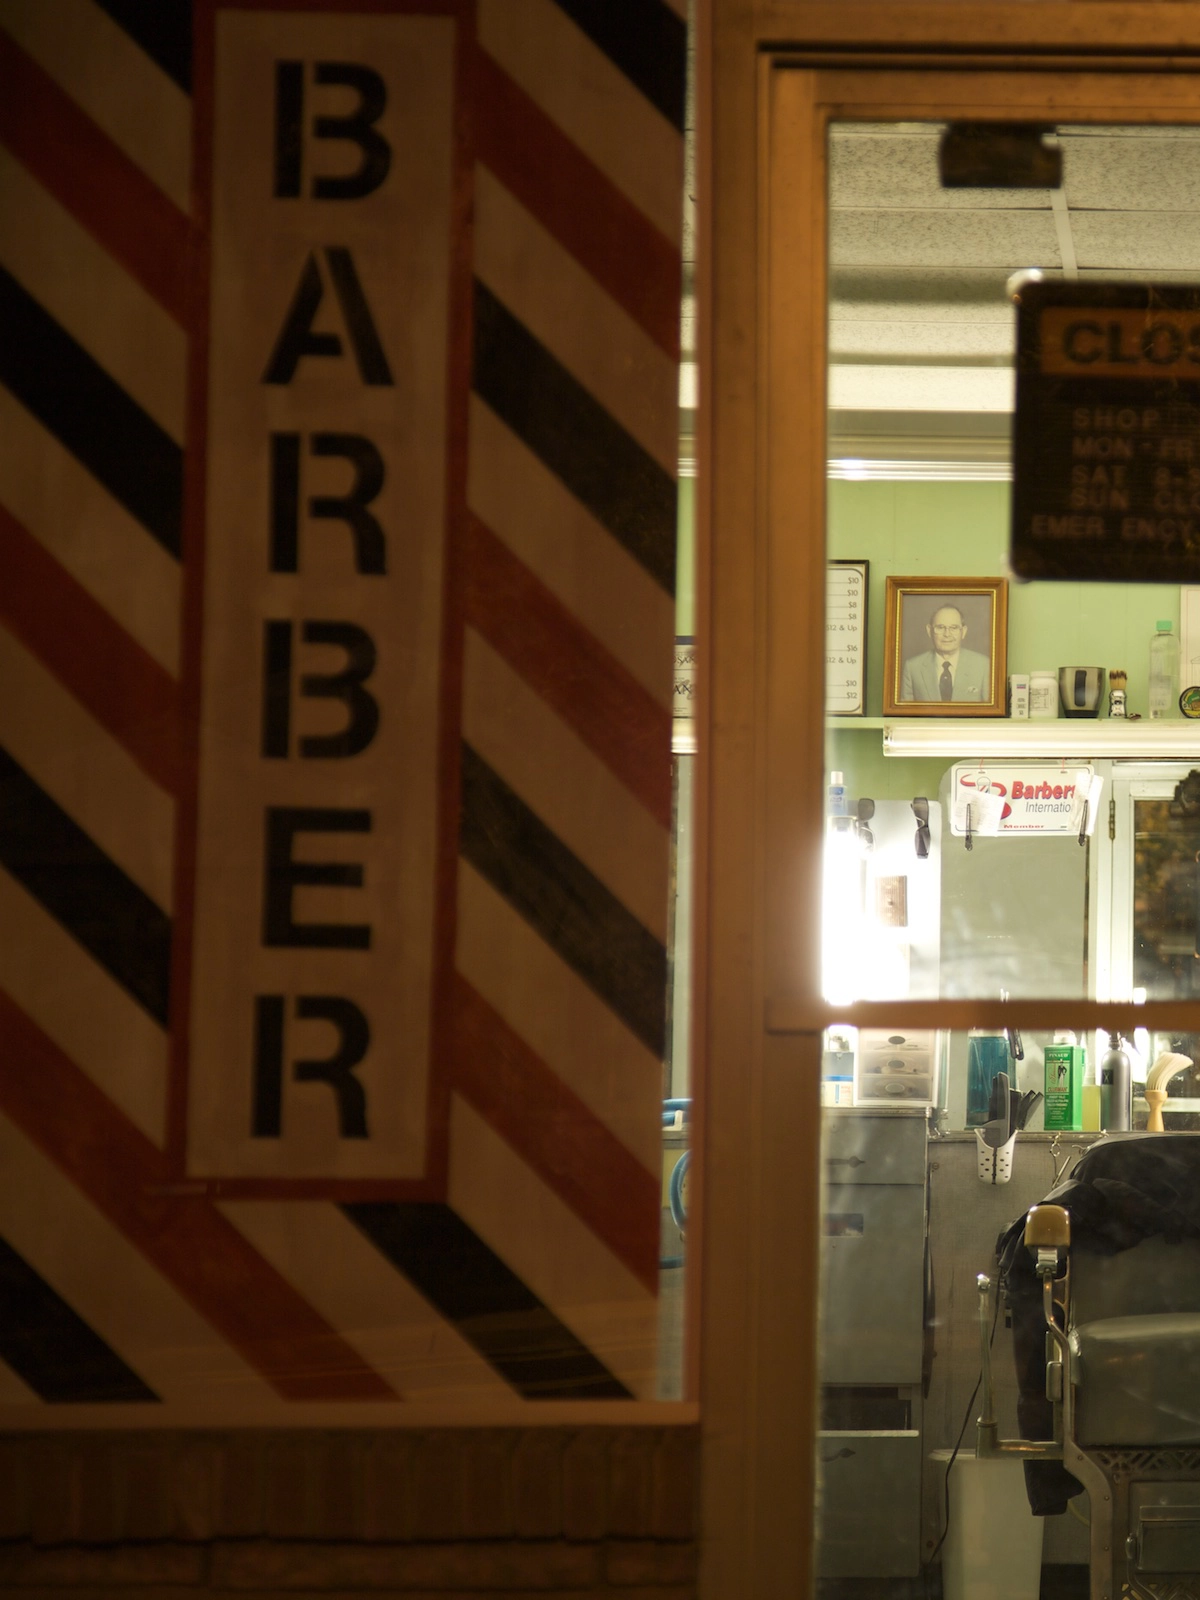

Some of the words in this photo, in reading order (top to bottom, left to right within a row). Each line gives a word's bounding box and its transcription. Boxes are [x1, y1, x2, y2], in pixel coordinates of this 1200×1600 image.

[1072, 407, 1160, 431] SHOP
[1072, 436, 1134, 459] MON
[1071, 464, 1128, 486] SAT
[1070, 487, 1130, 509] SUN
[249, 58, 397, 1142] BARBER
[846, 657, 857, 665] Up
[1025, 801, 1072, 813] Internatio
